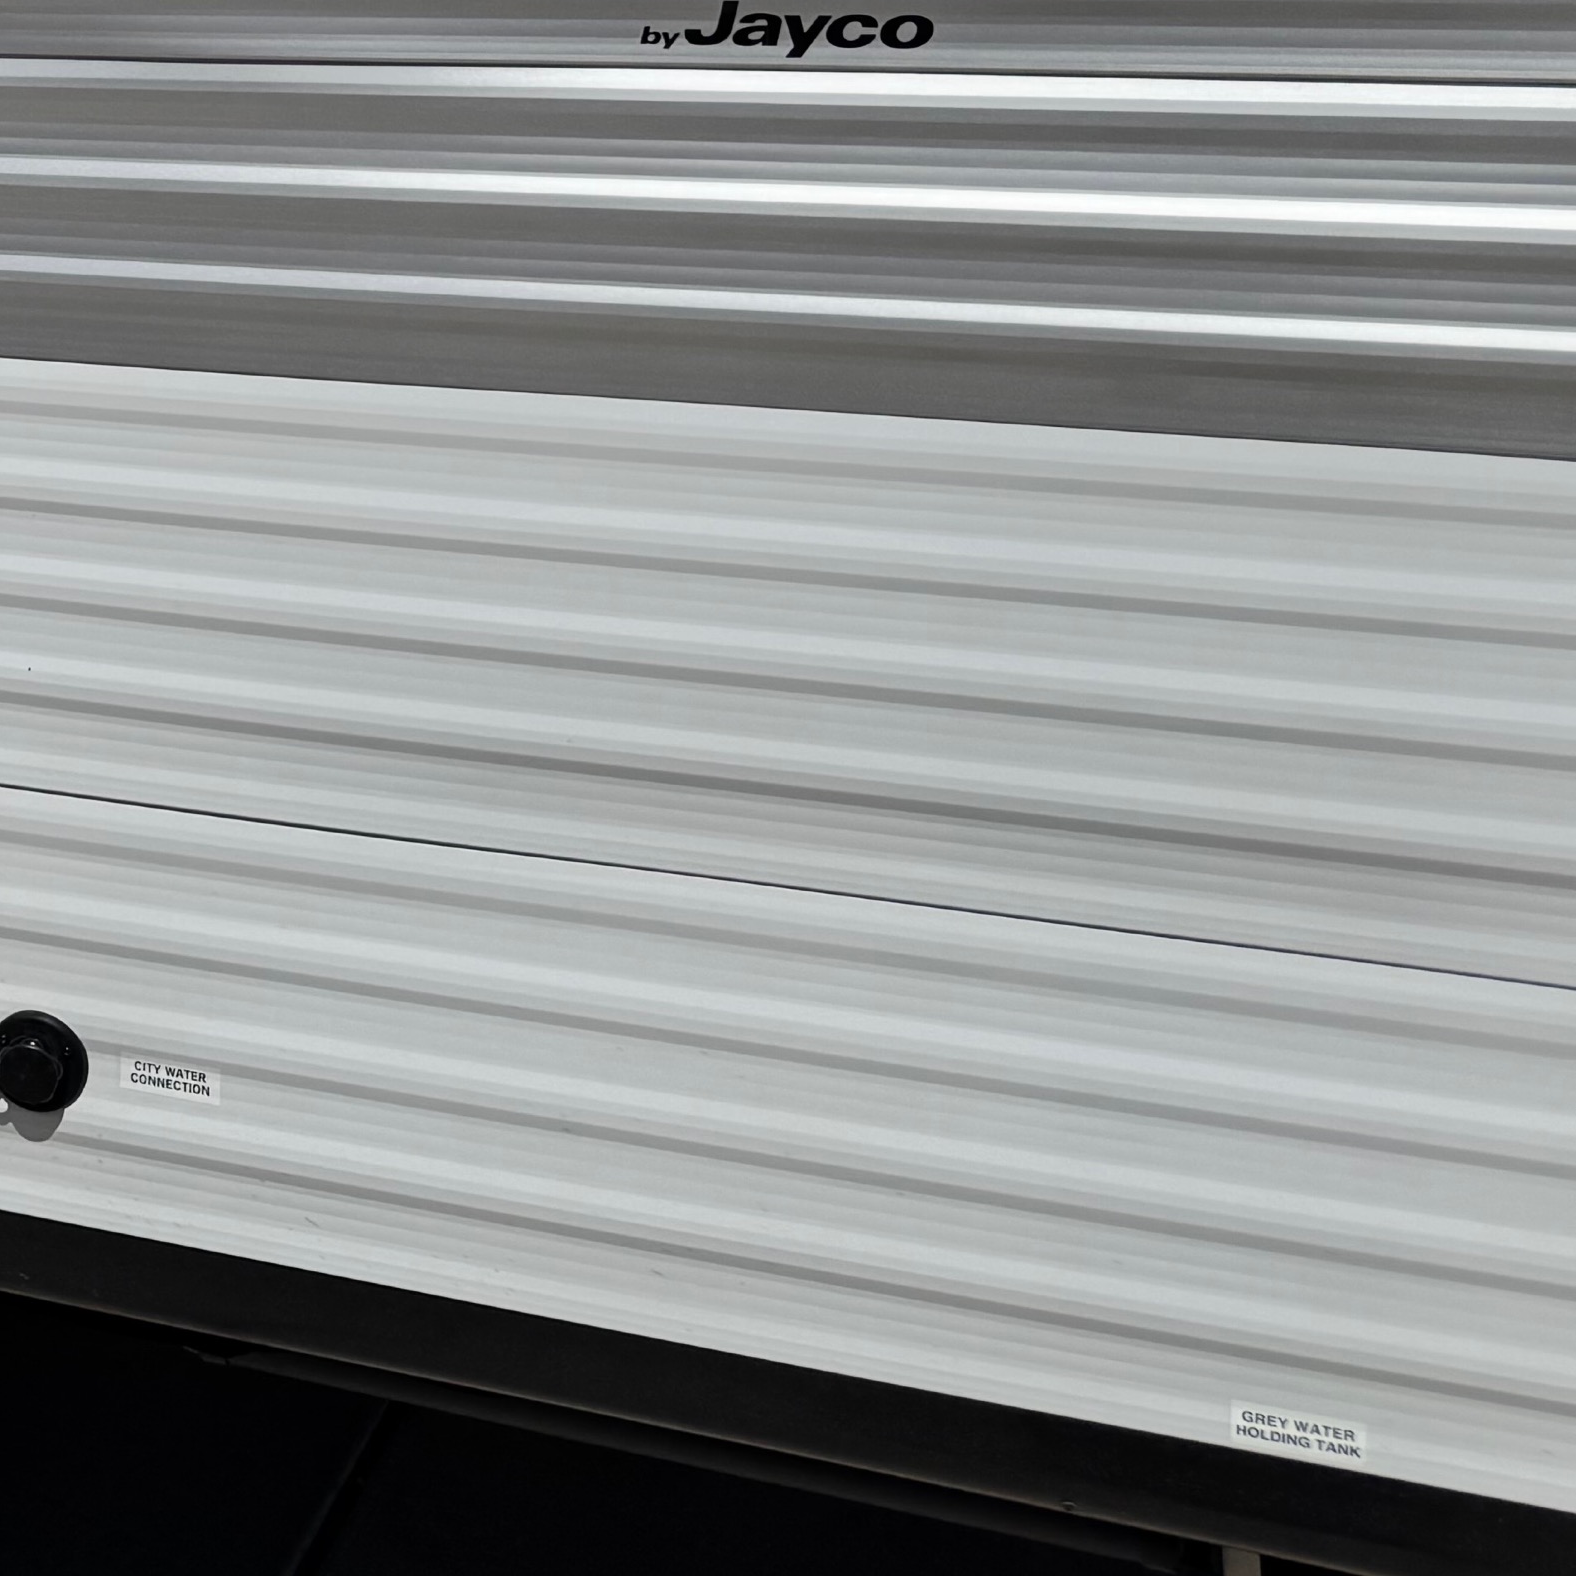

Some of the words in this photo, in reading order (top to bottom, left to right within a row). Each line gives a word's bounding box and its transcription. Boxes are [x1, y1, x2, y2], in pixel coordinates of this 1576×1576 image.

[640, 23, 680, 51] by
[684, 0, 935, 58] Jayco
[130, 1072, 211, 1097] CONNECTION
[134, 1060, 161, 1075] CITY
[165, 1066, 207, 1084] WATER
[1236, 1424, 1311, 1449] HOLDING
[1315, 1438, 1362, 1459] TANK
[1241, 1410, 1288, 1428] GREY
[1293, 1419, 1356, 1442] WATER
